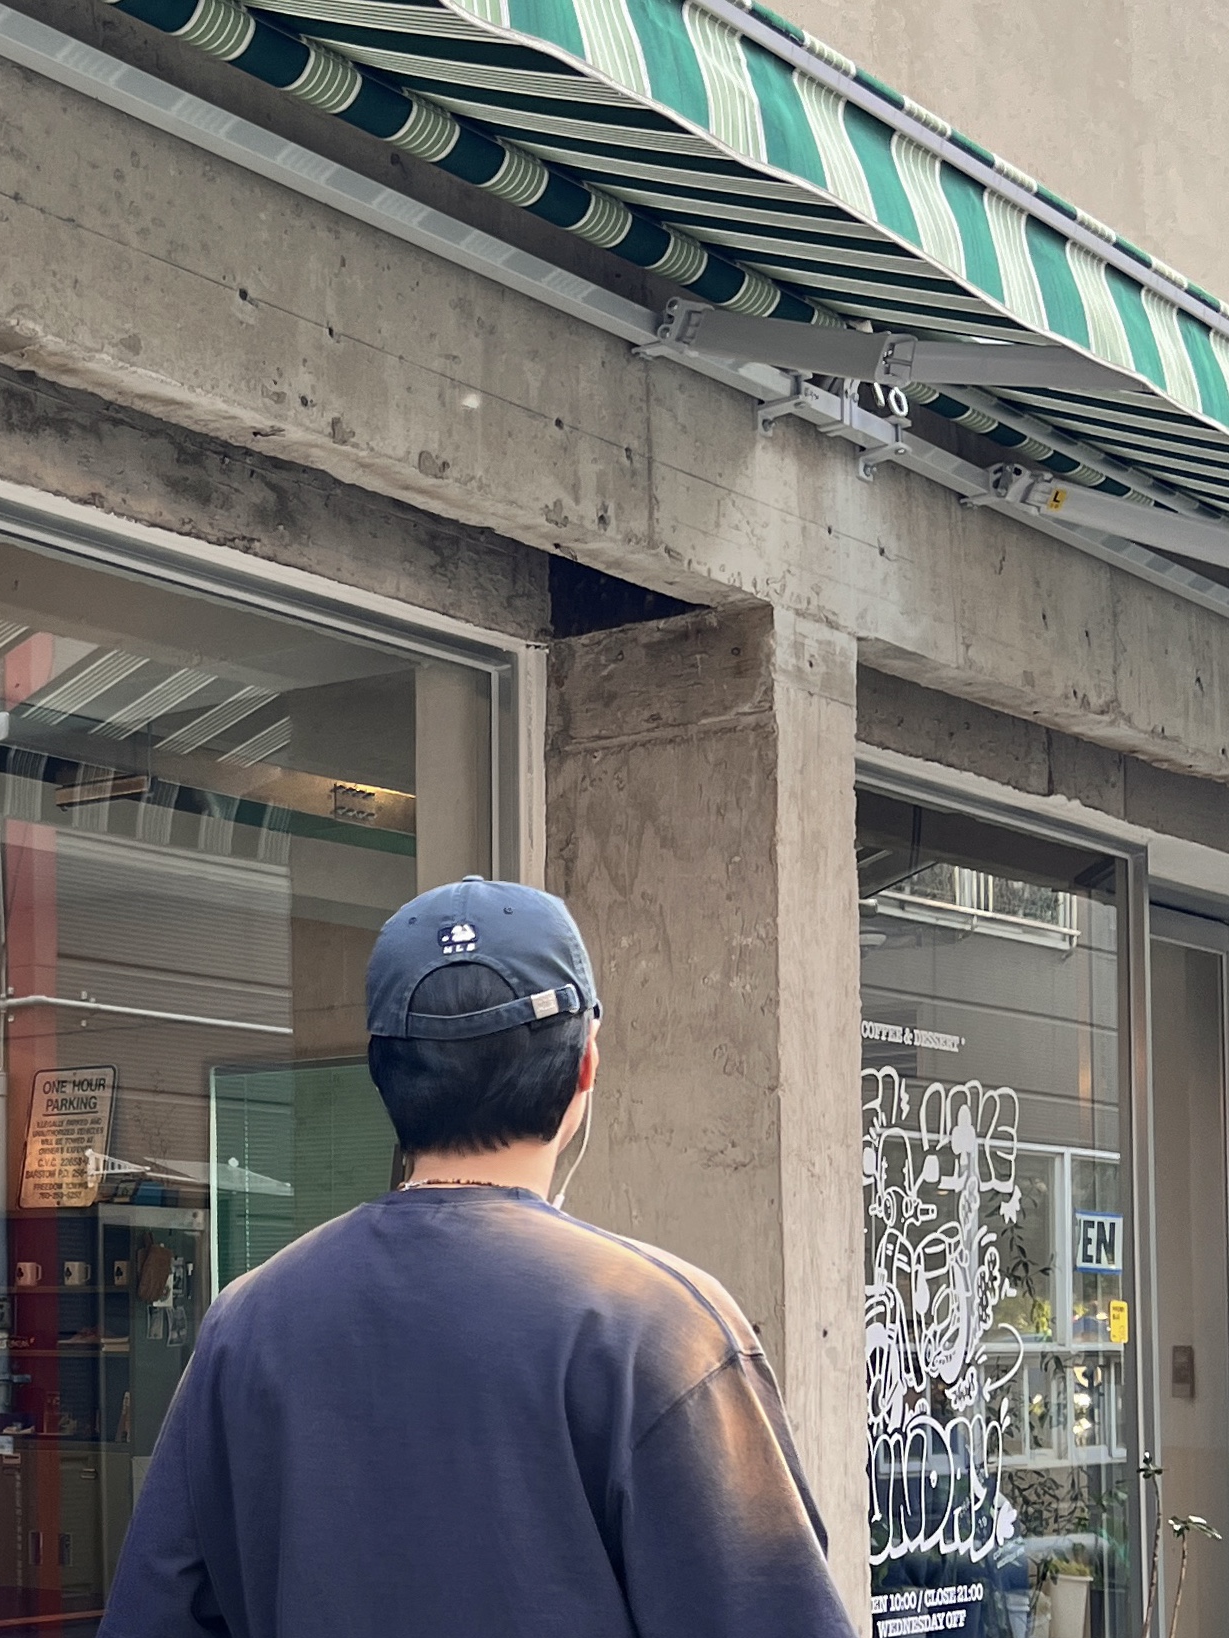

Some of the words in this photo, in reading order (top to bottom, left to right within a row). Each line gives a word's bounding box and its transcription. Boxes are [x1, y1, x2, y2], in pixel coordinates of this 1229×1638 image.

[862, 1020, 903, 1043] COFFEE
[904, 1027, 913, 1045] &
[913, 1029, 960, 1052] DESSERT
[43, 1080, 68, 1095] ONE
[73, 1078, 106, 1092] HOUR
[46, 1096, 98, 1111] PARKING
[1078, 1219, 1116, 1265] EN
[871, 1594, 889, 1614] EN
[889, 1591, 917, 1612] 10:00
[924, 1585, 957, 1607] CLOSE
[957, 1582, 984, 1603] 21:00
[876, 1612, 946, 1638] WEDNESDAY
[946, 1609, 967, 1629] OFF
